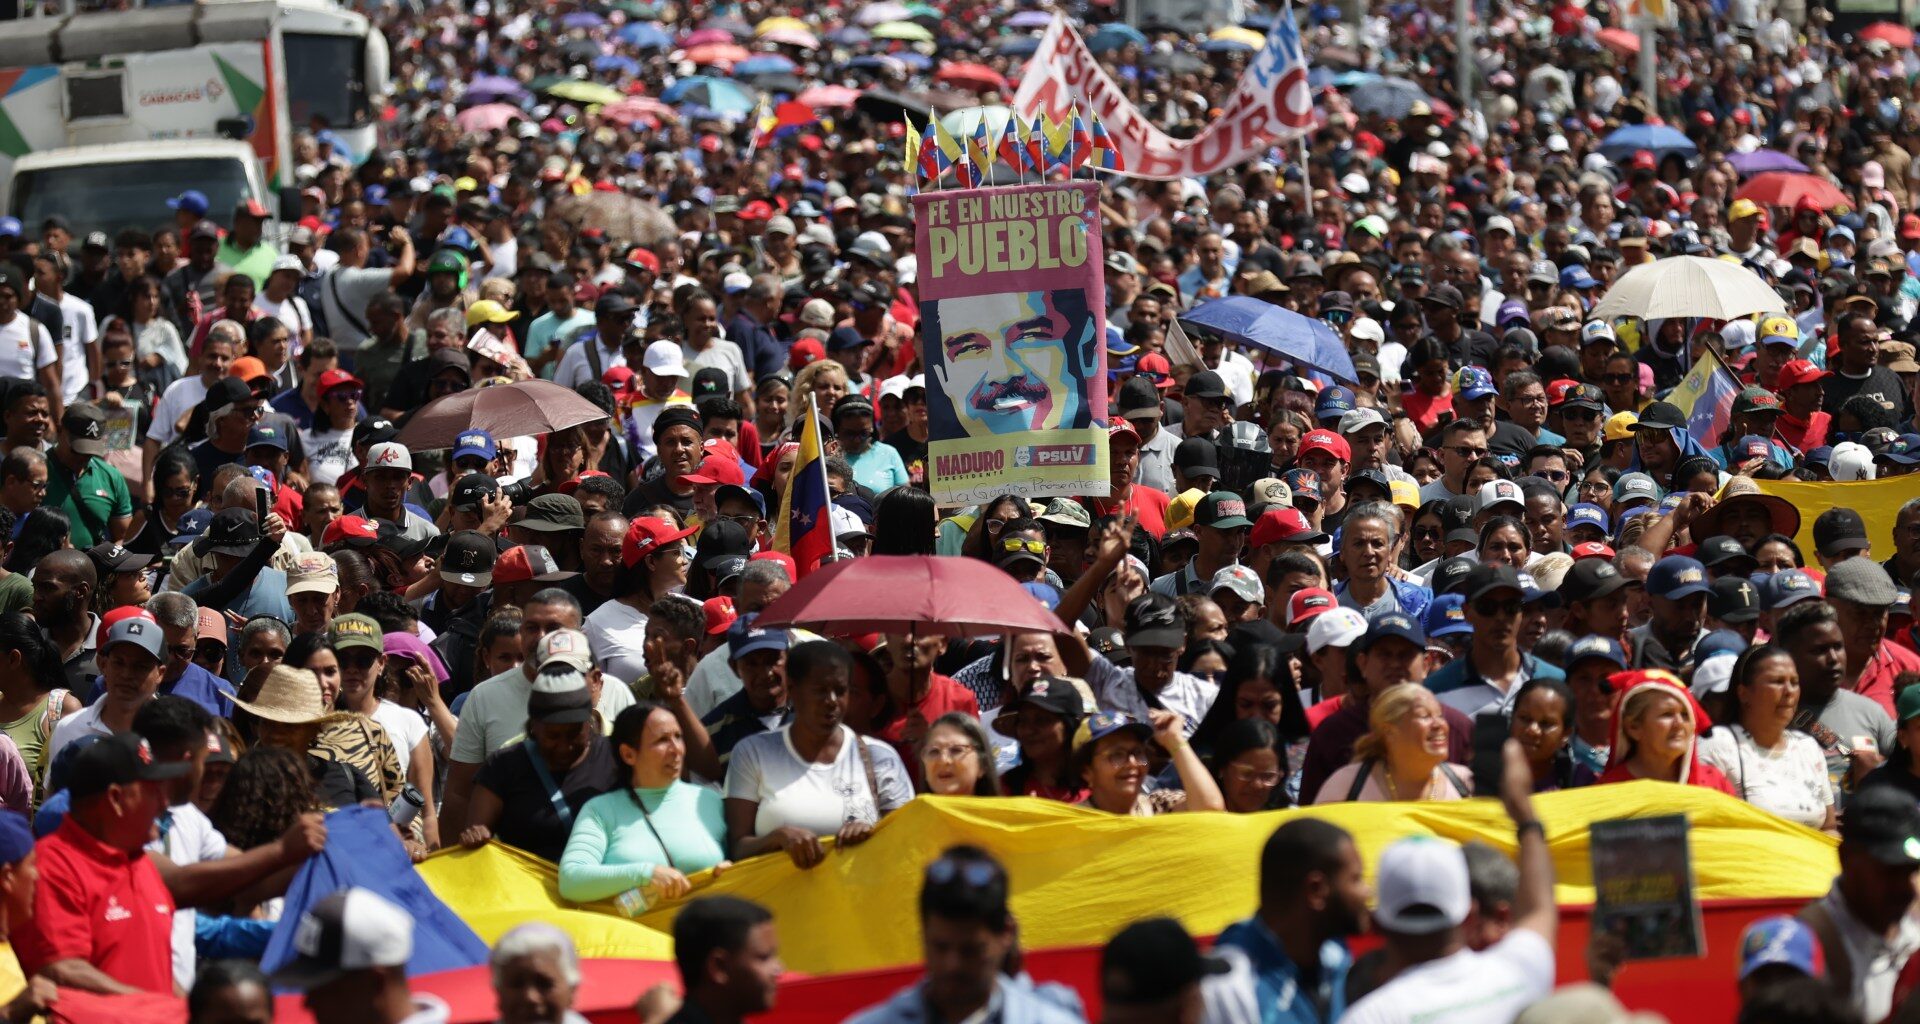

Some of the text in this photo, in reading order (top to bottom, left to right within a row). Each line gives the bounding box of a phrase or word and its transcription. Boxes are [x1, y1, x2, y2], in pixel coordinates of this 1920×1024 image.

[928, 188, 1085, 226] FE EN NUESTRO
[928, 215, 1088, 279] PUEBLO
[1322, 400, 1350, 409] MINEC
[936, 449, 1005, 477] MADURO
[937, 470, 1004, 482] PRESIDENTE
